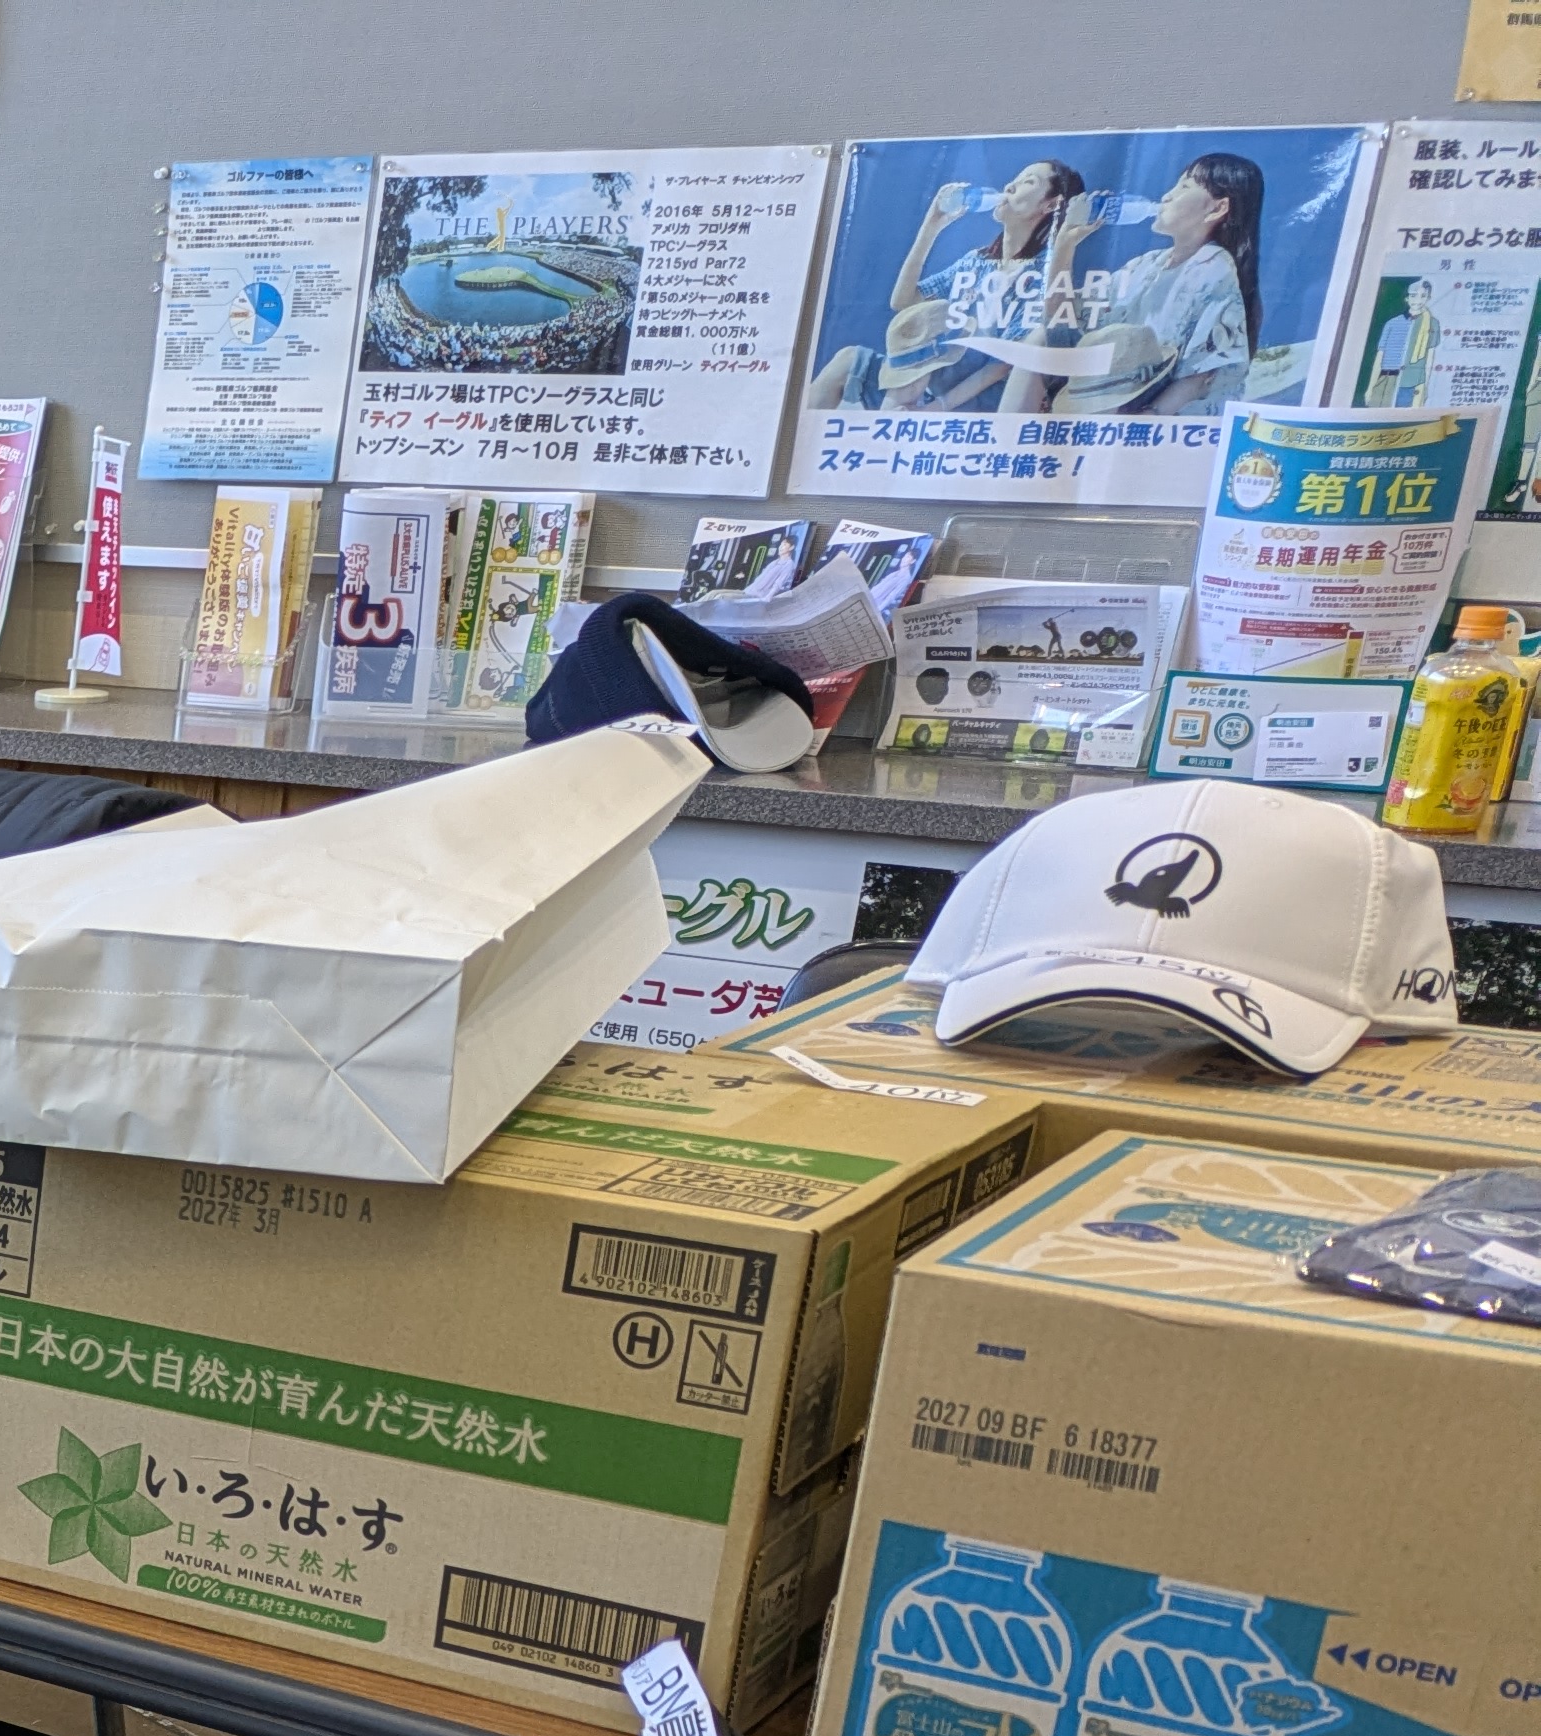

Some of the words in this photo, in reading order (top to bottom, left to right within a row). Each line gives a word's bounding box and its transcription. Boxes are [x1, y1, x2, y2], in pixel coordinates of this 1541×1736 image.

[226, 168, 315, 183] ゴルファーの皆様へ
[732, 173, 805, 185] チャンピオンシップ
[654, 204, 703, 219] 2016年
[436, 217, 488, 237] THE
[512, 215, 629, 236] PLAYERS
[652, 222, 690, 236] アメリカ
[698, 221, 750, 235] フロリダ州
[649, 240, 728, 253] TPCソーグラス
[647, 257, 697, 271] 7215yd
[705, 256, 746, 270] Par72
[644, 273, 736, 287] 4大メジャーに次ぐ
[949, 269, 1131, 300] POCARI
[638, 308, 746, 322] 持つビッグトーナメント
[944, 300, 1113, 331] SWEAT
[630, 359, 693, 373] 使用グリーン
[700, 360, 771, 374] ティフイーグル
[363, 383, 665, 407] 玉村ゴルフ場はTPCソーグラスと同じ
[1271, 427, 1417, 448] 個人年金保険ランキング
[355, 435, 465, 458] トップシーズン
[593, 444, 754, 466] 是非ご体感下さい。
[1328, 456, 1419, 470] 資料請求件数
[818, 450, 1085, 479] スタート前にご準備を！
[1295, 472, 1438, 516] 第1位
[703, 521, 747, 533] Z-GYM
[839, 523, 880, 538] Z-GYM
[97, 495, 113, 592] 使えます
[1255, 540, 1389, 567] 長期運用年金
[929, 649, 968, 658] GARMIN
[845, 1081, 975, 1106] 40位
[180, 1168, 271, 1203] 0015825
[281, 1184, 348, 1219] #1510
[358, 1197, 373, 1223] A
[178, 1196, 242, 1230] 2027年
[253, 1206, 280, 1236] 3月
[624, 1321, 661, 1360] H
[915, 1397, 973, 1429] 2027
[975, 1408, 1006, 1436] 09
[1012, 1414, 1049, 1444] BF
[1063, 1424, 1080, 1451] 6
[1089, 1427, 1160, 1462] 18377
[176, 1521, 359, 1584] 日本の天然水
[163, 1549, 232, 1577] NATURAL
[237, 1566, 305, 1594] MINERAL
[309, 1582, 364, 1609] WATER
[164, 1568, 222, 1600] 100%
[492, 1639, 515, 1655] 049
[520, 1645, 557, 1665] 02102
[563, 1656, 601, 1674] 14860
[1375, 1652, 1458, 1687] OPEN
